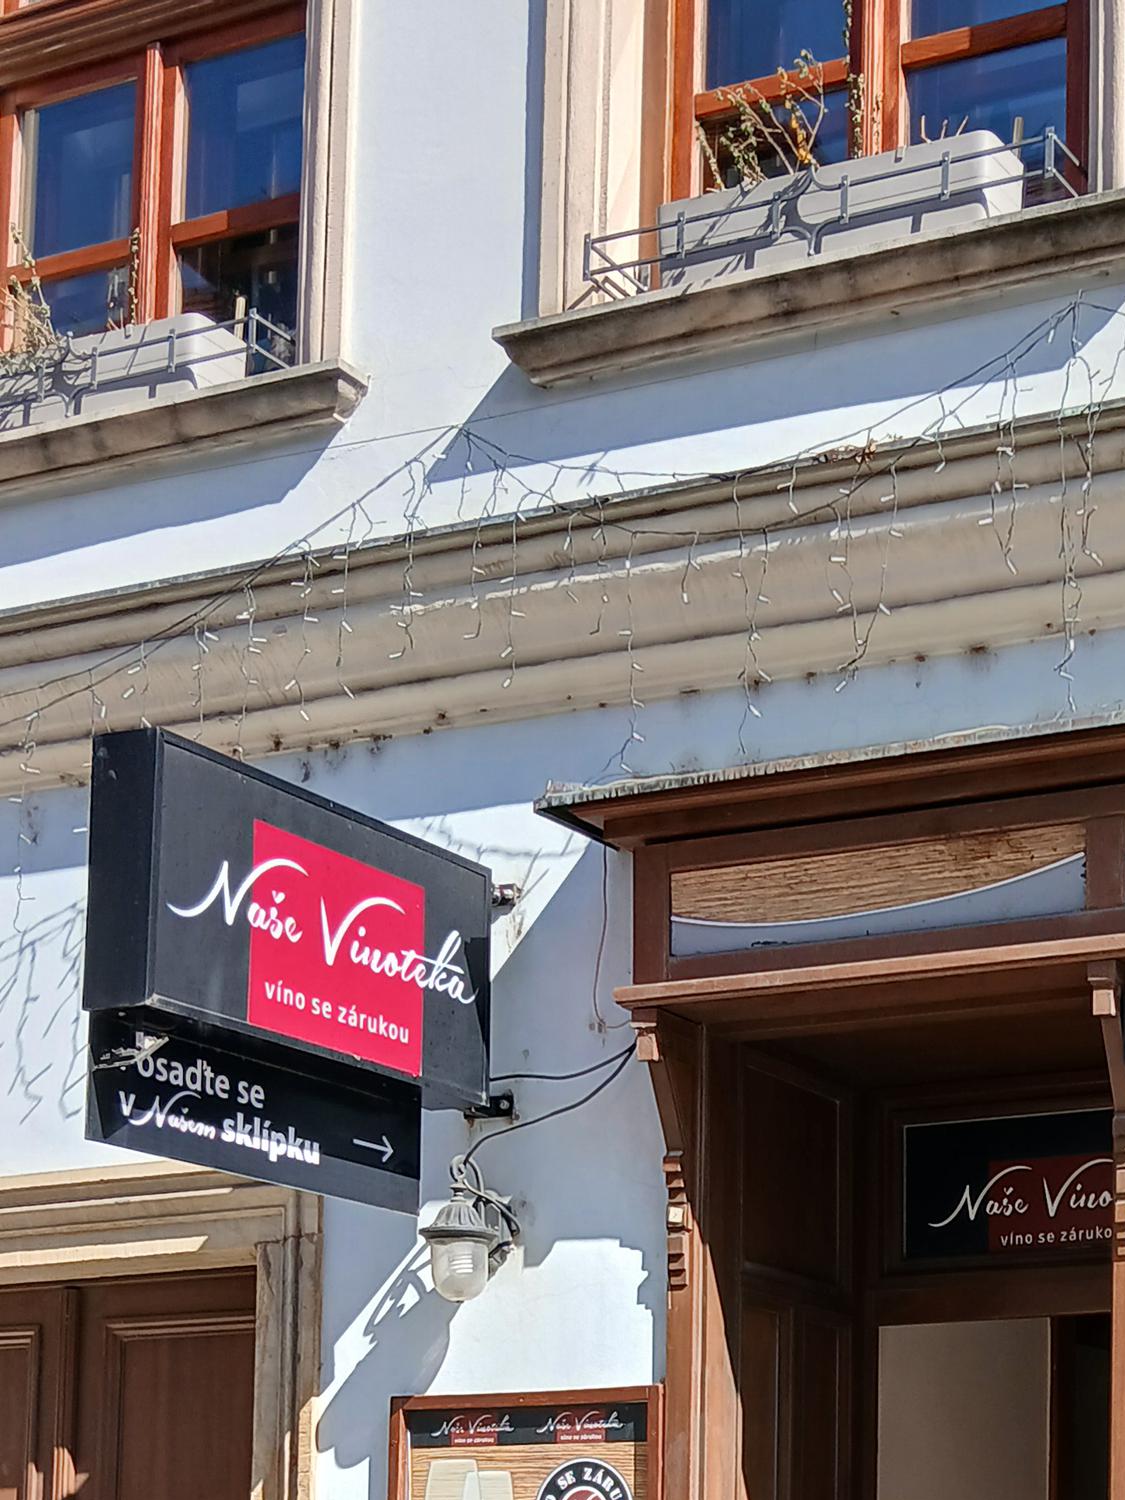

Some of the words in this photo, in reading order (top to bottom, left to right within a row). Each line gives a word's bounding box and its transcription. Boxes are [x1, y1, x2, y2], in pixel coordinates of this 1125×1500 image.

[166, 859, 308, 943] Naše
[321, 897, 480, 1004] Vinoteka
[265, 980, 306, 1010] víno
[311, 997, 332, 1019] se
[337, 1004, 410, 1044] zárukou
[121, 1053, 230, 1099] osaďte
[237, 1080, 265, 1108] se
[128, 1091, 216, 1140] Našem
[221, 1112, 321, 1165] sklípku
[928, 1165, 1032, 1227] Naše
[1043, 1158, 1113, 1217] Vino
[1000, 1231, 1033, 1246] víno
[1038, 1231, 1055, 1244] se
[1060, 1226, 1113, 1243] záruko
[557, 1471, 577, 1491] SE
